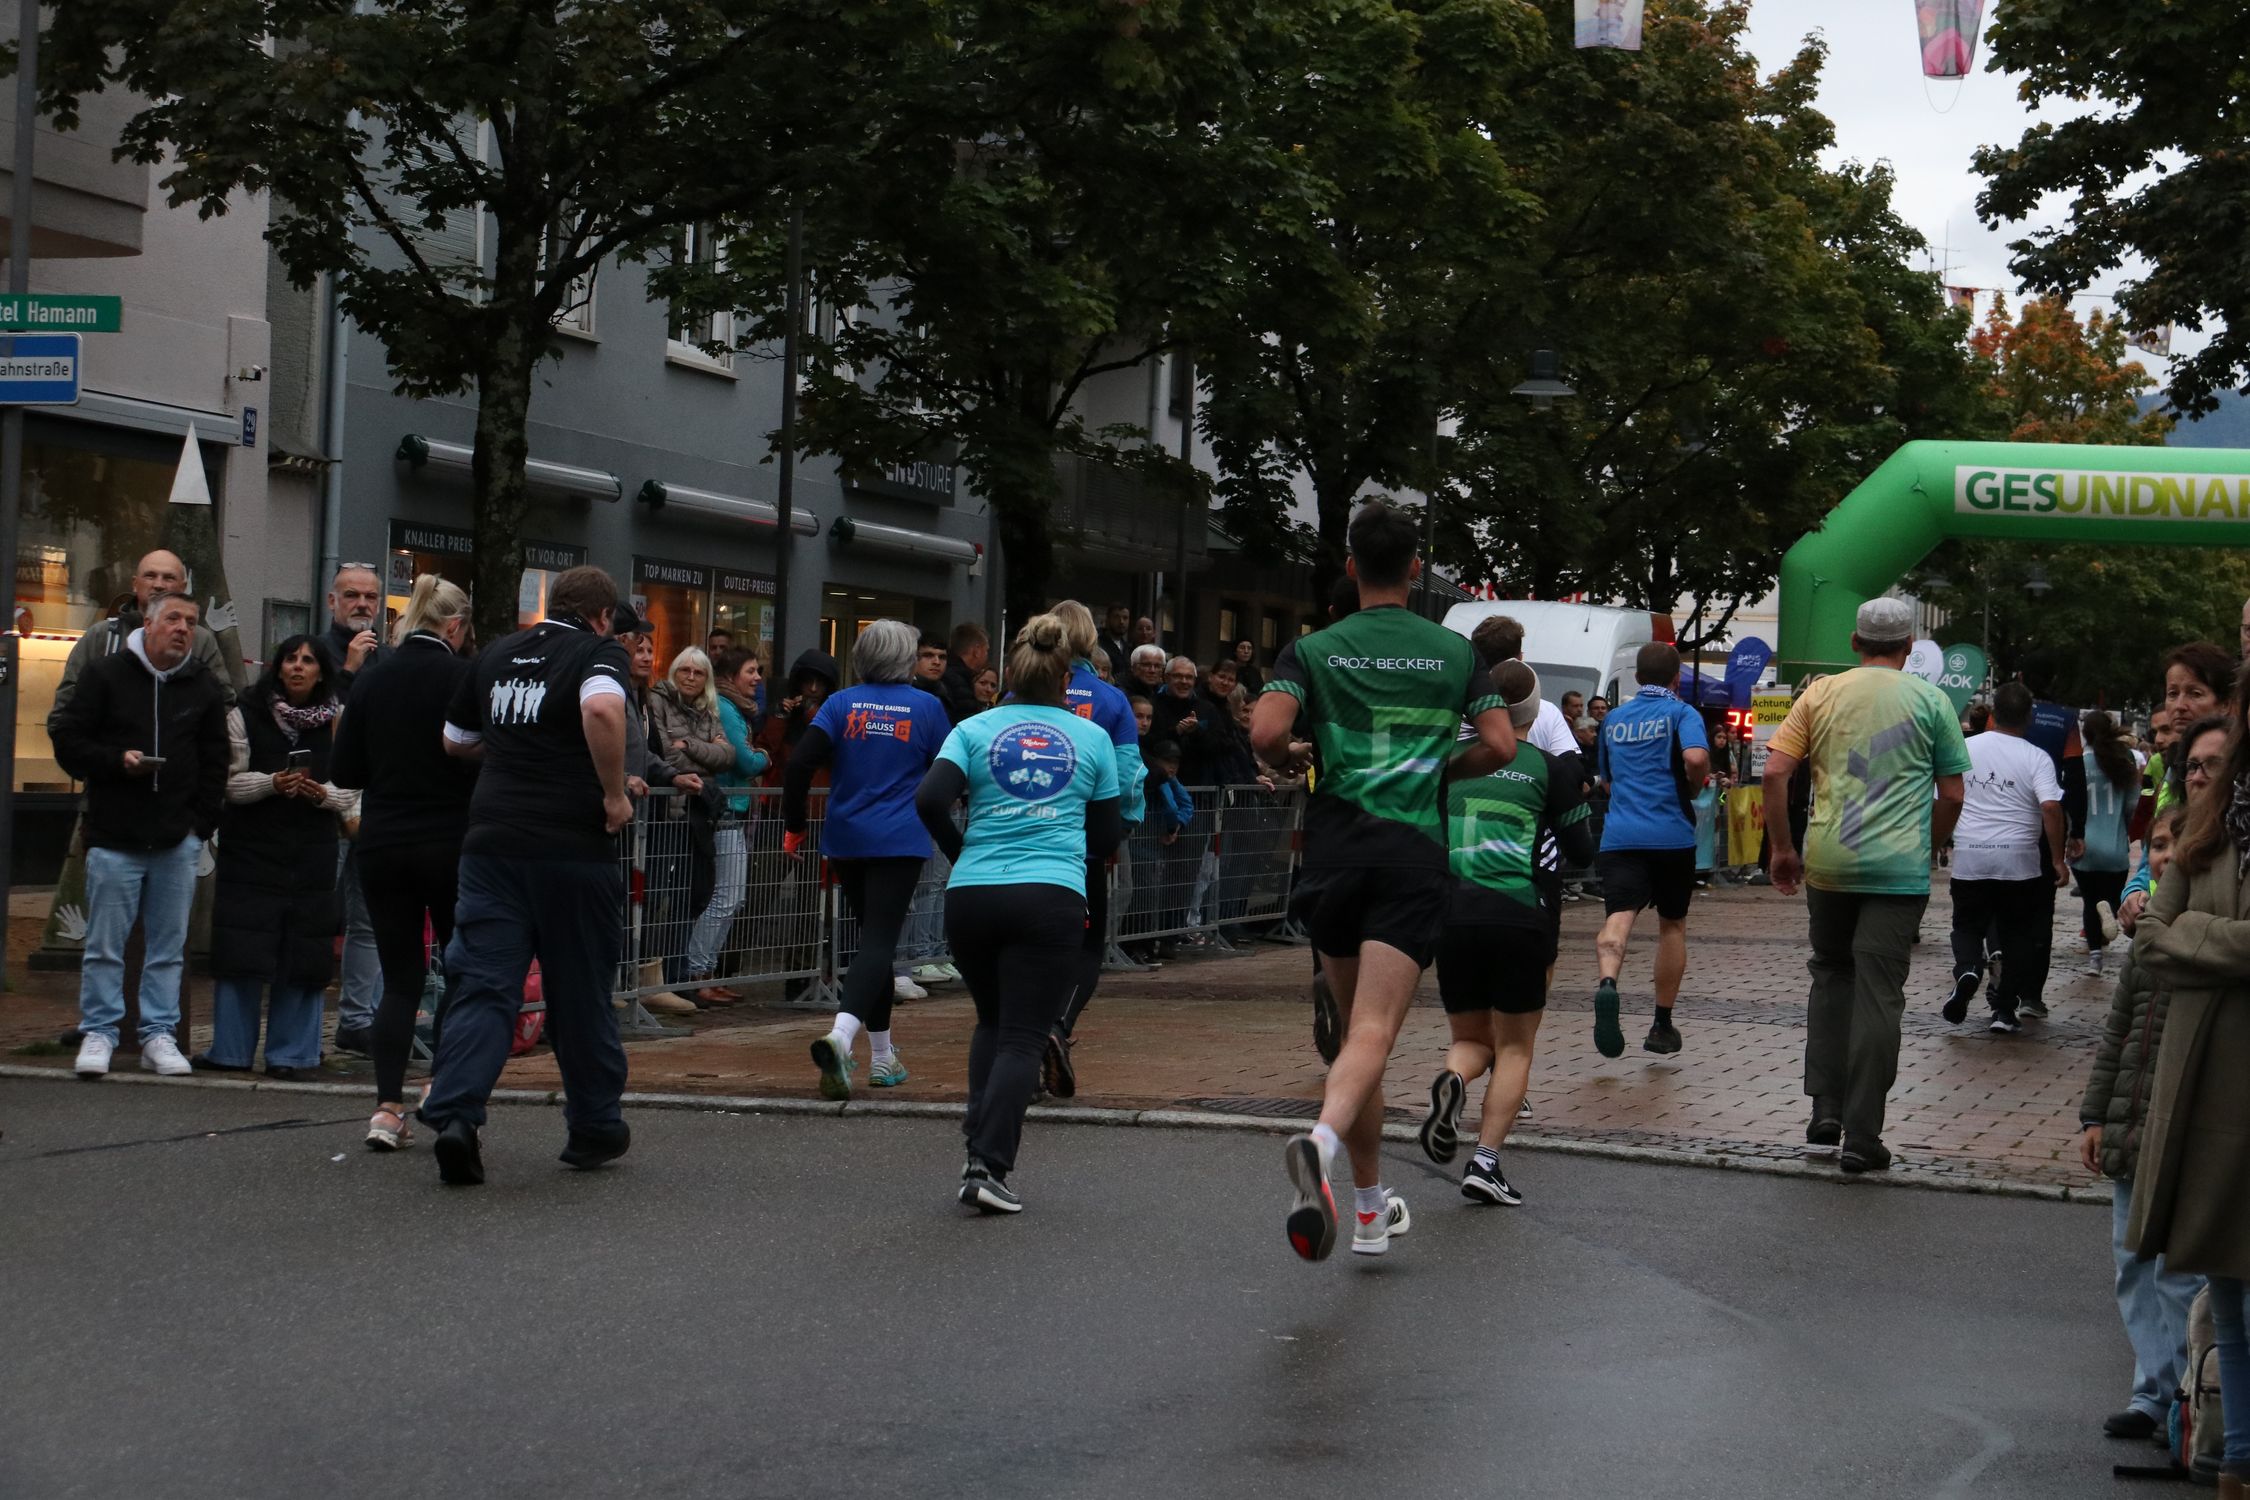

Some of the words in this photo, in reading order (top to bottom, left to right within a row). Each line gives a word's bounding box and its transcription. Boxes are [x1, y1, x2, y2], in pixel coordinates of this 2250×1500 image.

[28, 301, 97, 323] Hamann
[0, 361, 69, 376] ahnstraße
[246, 412, 256, 433] 29
[404, 528, 445, 549] KNALLER
[448, 535, 473, 553] PREIS
[537, 549, 555, 563] VOR
[557, 552, 574, 567] ORT
[644, 563, 658, 577] TOP
[660, 566, 691, 583] MARKEN
[692, 571, 703, 585] ZU
[1327, 655, 1445, 671] GROZ-BECKERT
[1937, 673, 1973, 689] AOK
[1065, 688, 1093, 697] GAUSSIS
[862, 702, 884, 711] FITTEN
[884, 704, 911, 713] GAUSSIS
[865, 721, 895, 732] GAUSS
[1605, 716, 1671, 746] POLIZEI
[1487, 769, 1536, 784] CKERT
[2086, 782, 2114, 815] 11
